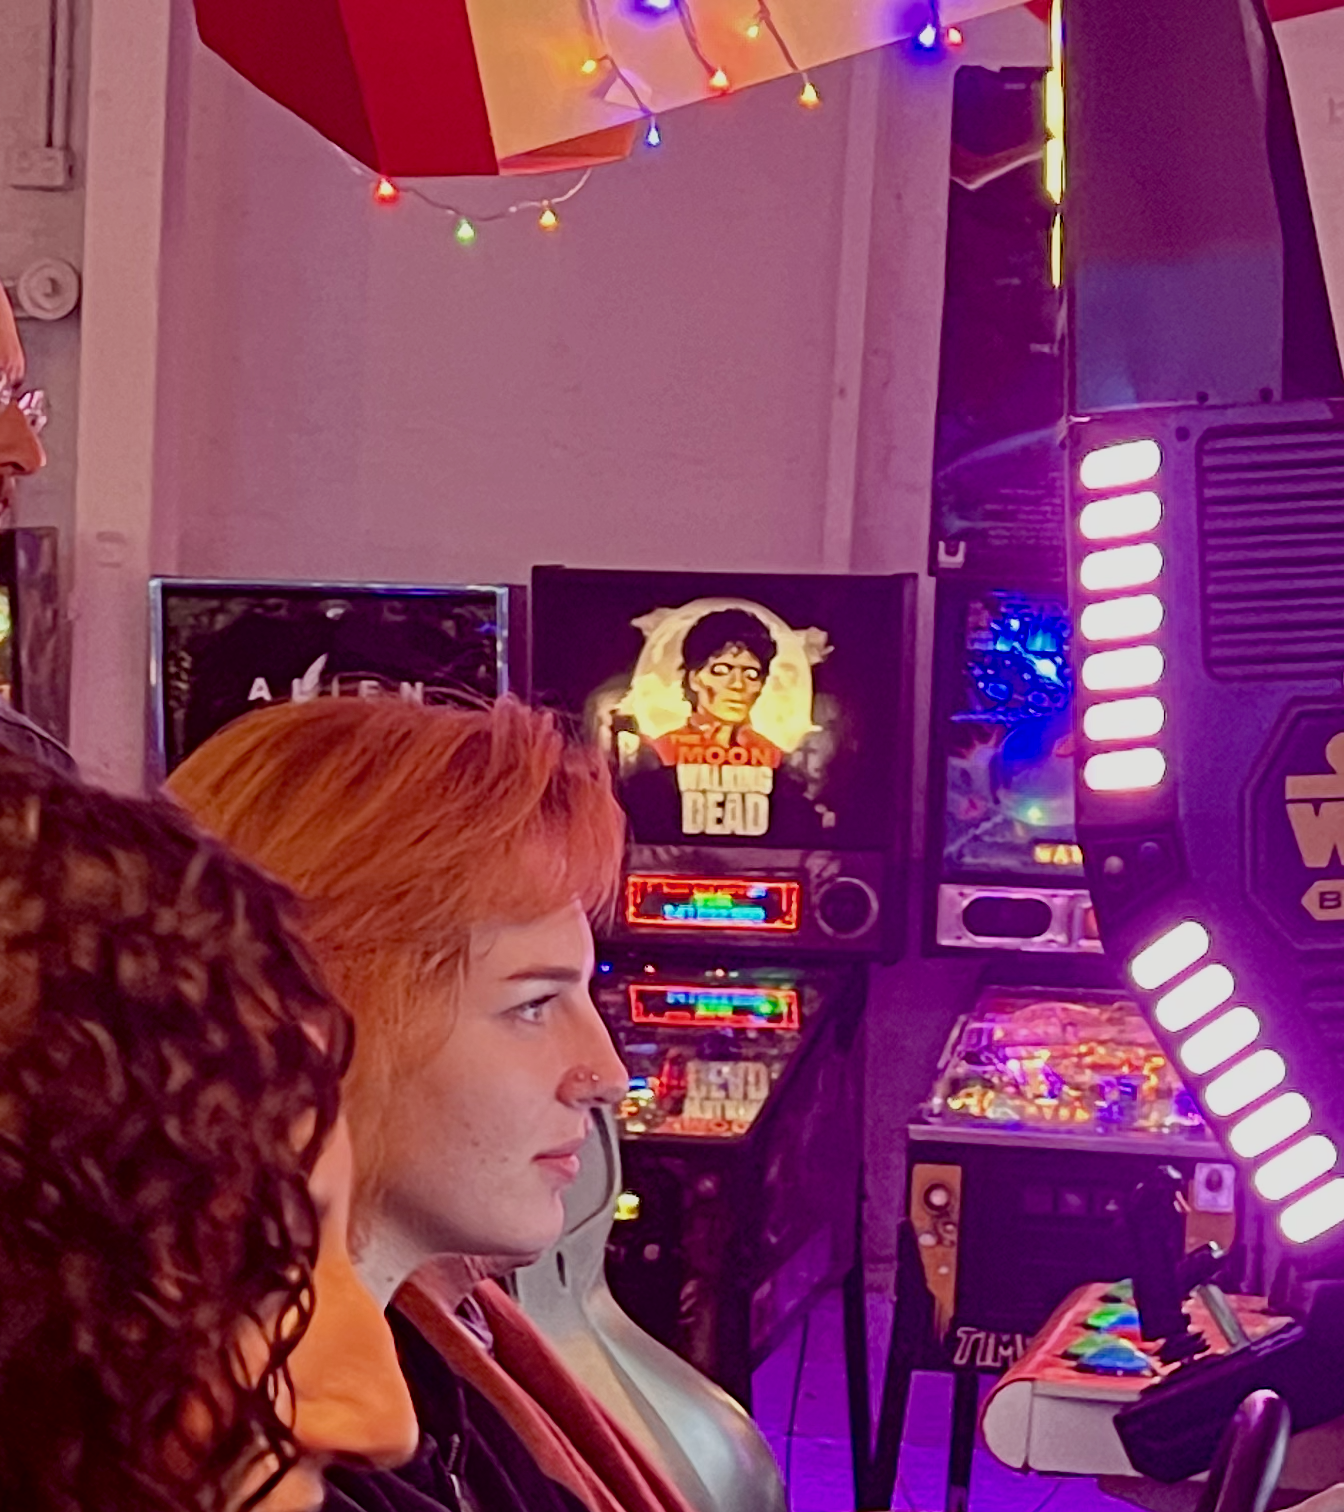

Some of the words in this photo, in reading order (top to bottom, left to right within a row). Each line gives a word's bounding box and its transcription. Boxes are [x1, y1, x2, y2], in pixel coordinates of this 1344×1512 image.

[247, 676, 424, 704] ALIEN
[677, 746, 771, 766] MOON
[681, 790, 769, 836] DEAD
